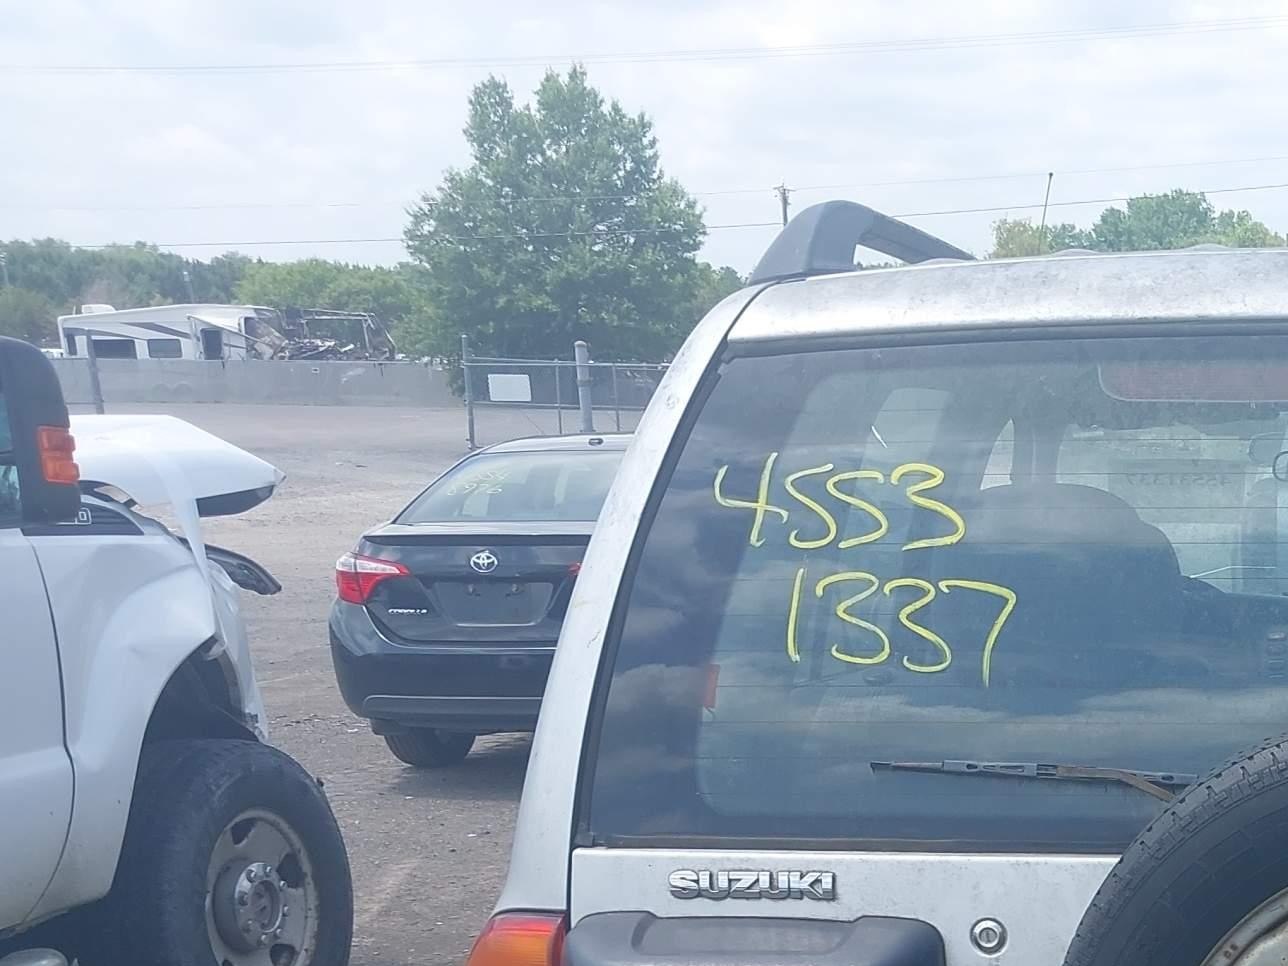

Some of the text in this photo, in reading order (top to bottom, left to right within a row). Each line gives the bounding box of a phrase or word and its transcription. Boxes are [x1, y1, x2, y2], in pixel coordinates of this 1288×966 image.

[713, 452, 966, 550] 4553
[786, 568, 1017, 688] 1337
[668, 869, 836, 900] SUZUKI
